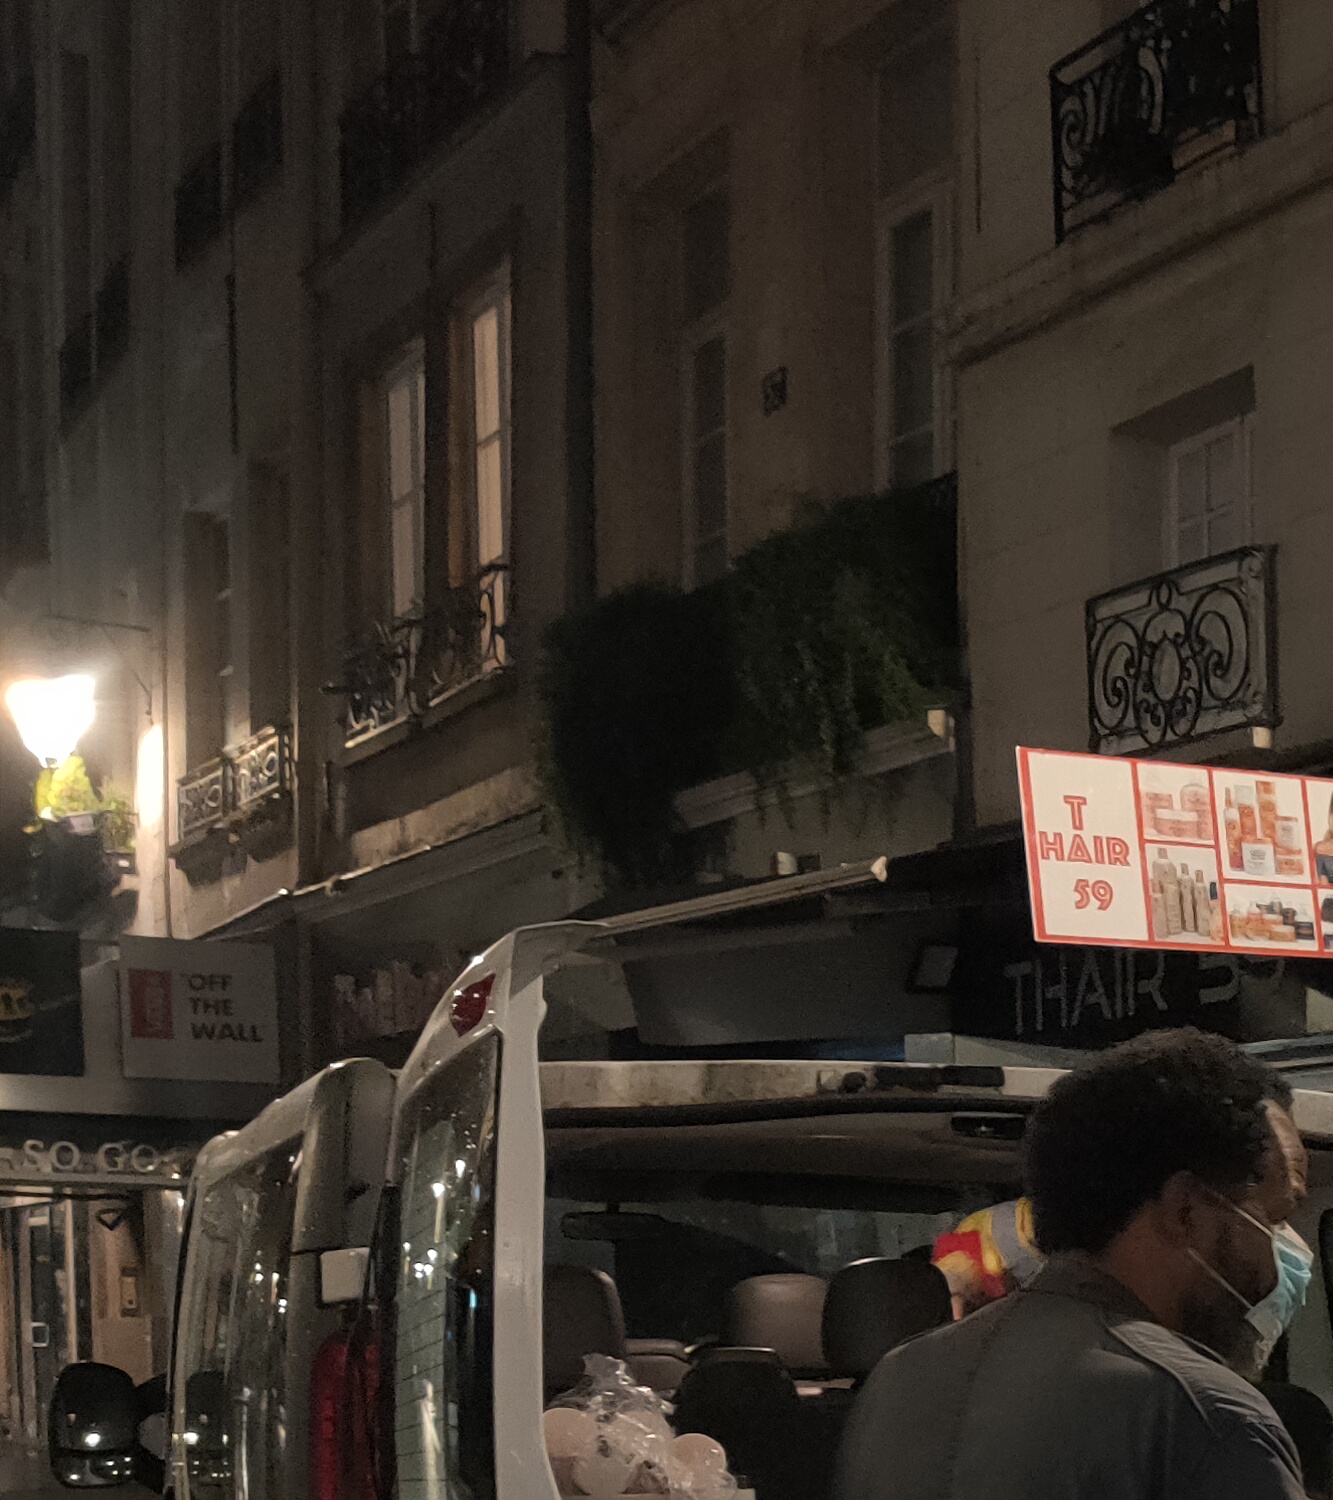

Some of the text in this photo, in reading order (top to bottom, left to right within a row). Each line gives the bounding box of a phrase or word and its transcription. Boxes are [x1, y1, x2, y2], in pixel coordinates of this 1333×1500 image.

[1064, 795, 1087, 831] T
[1039, 831, 1131, 867] HAIR
[1073, 878, 1114, 911] 59
[188, 997, 234, 1017] THE
[190, 1023, 264, 1043] WALL
